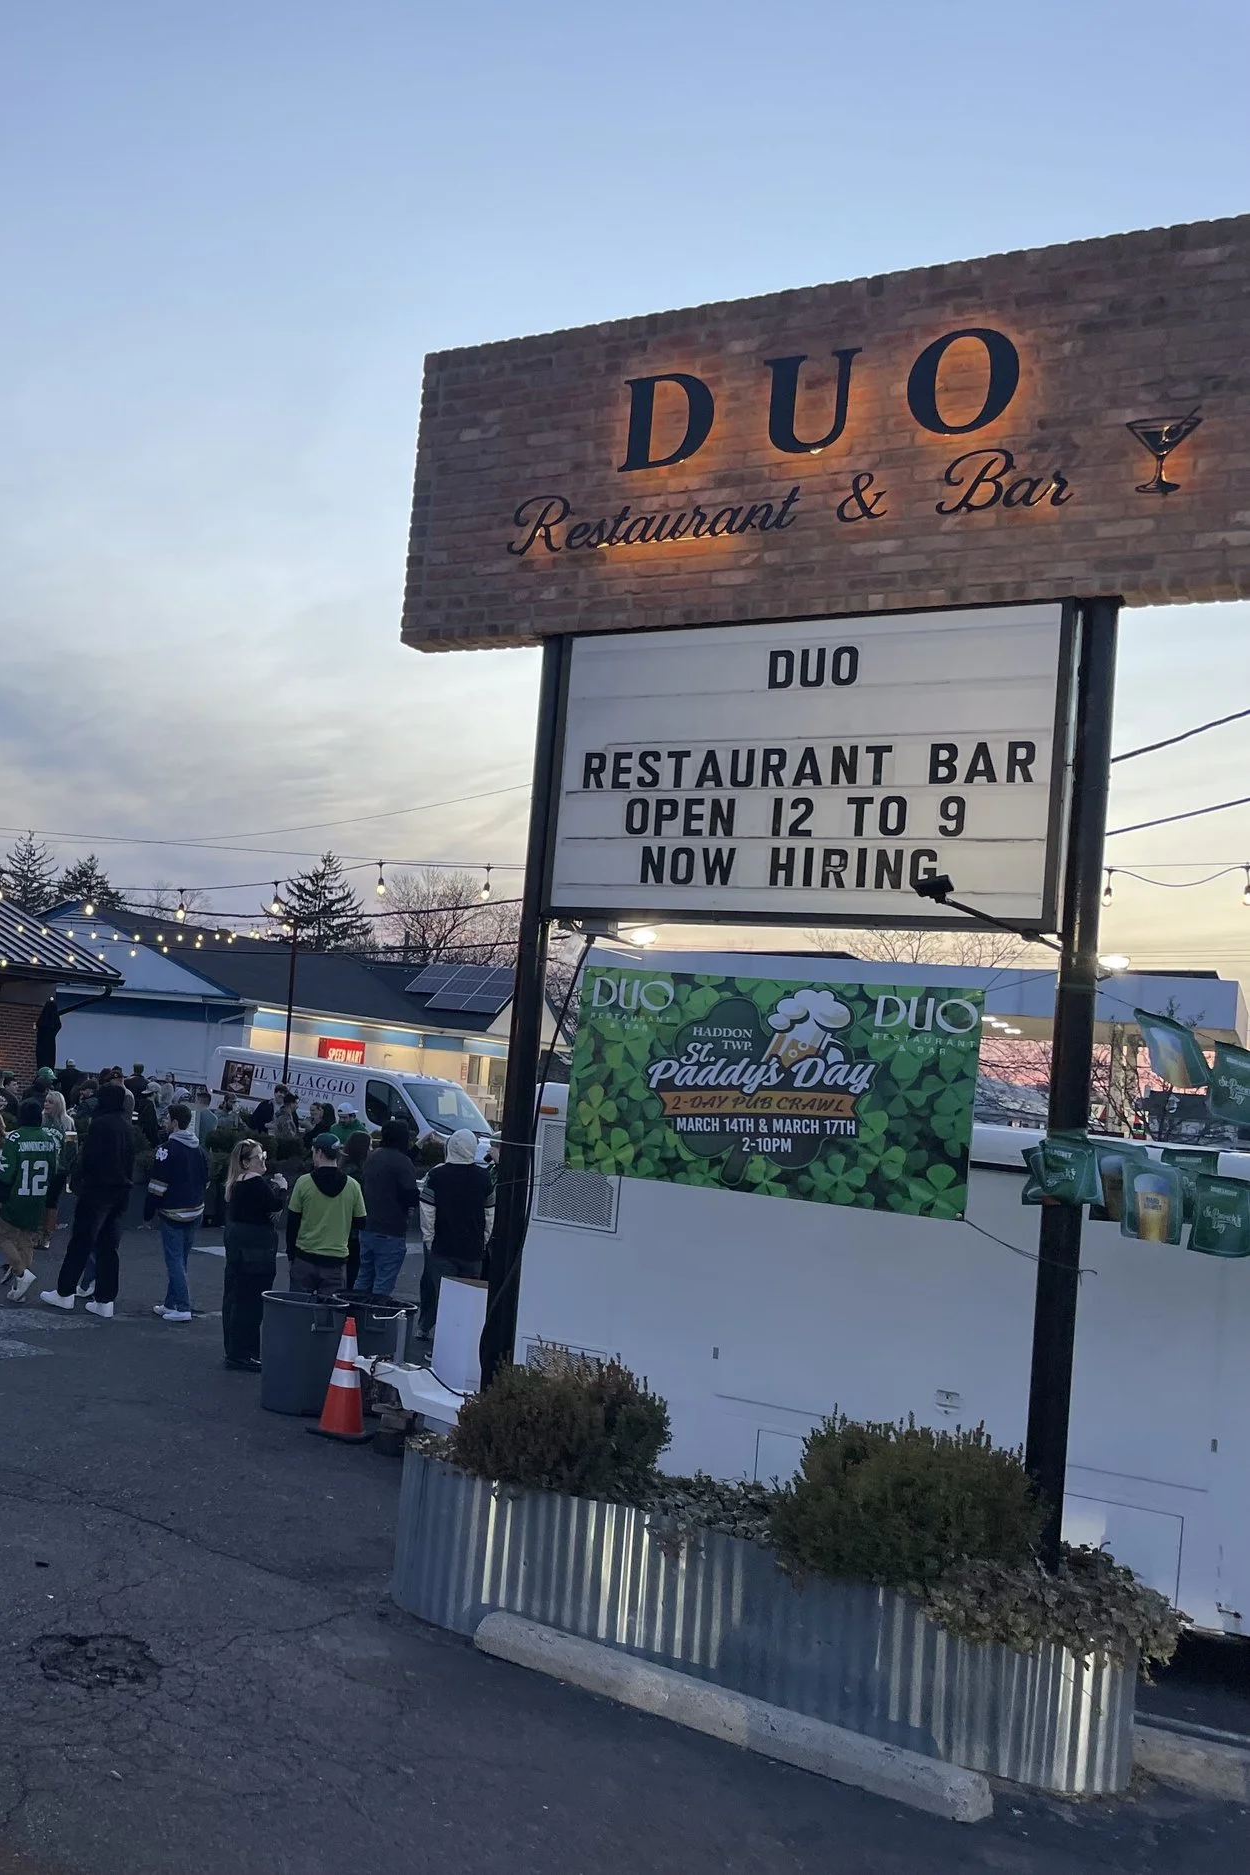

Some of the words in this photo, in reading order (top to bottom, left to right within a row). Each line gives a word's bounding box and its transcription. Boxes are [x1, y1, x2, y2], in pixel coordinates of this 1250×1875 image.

[616, 327, 1021, 473] DUO
[507, 486, 801, 557] Restaurant
[836, 472, 888, 524] &
[936, 449, 1075, 516] Bar
[768, 646, 859, 689] DUO
[582, 745, 893, 790] RESTAURANT
[929, 741, 1037, 784] BAR
[625, 799, 736, 837] OPEN
[770, 798, 814, 837] 12
[847, 796, 908, 836] TO
[939, 795, 967, 836] 9
[639, 846, 737, 886] NOW
[768, 847, 940, 891] HIRING
[592, 977, 675, 1011] DUO
[590, 1012, 671, 1024] RESTAURANT
[874, 995, 979, 1034] DUO
[693, 1026, 753, 1039] HADDON
[722, 1040, 753, 1051] TWP.
[872, 1032, 976, 1048] RESTAURANT
[327, 1047, 346, 1062] SPEED
[346, 1049, 363, 1064] MART
[680, 1041, 716, 1065] St.
[917, 1046, 946, 1056] BAR
[254, 1066, 267, 1080] IL
[272, 1069, 355, 1095] VLLAGGIO
[648, 1057, 785, 1094] Paddy's
[791, 1056, 877, 1094] Day
[267, 1083, 336, 1101] RAURANT
[671, 1095, 730, 1111] 2-DAY
[732, 1096, 772, 1111] PUB
[776, 1096, 845, 1113] CRAWL
[676, 1117, 720, 1132] MARCH
[723, 1118, 755, 1133] 14TH
[758, 1118, 768, 1133] &
[772, 1119, 820, 1134] MARCH
[823, 1120, 856, 1135] 17TH
[742, 1138, 792, 1152] 2-10PM
[18, 1160, 49, 1196] 12
